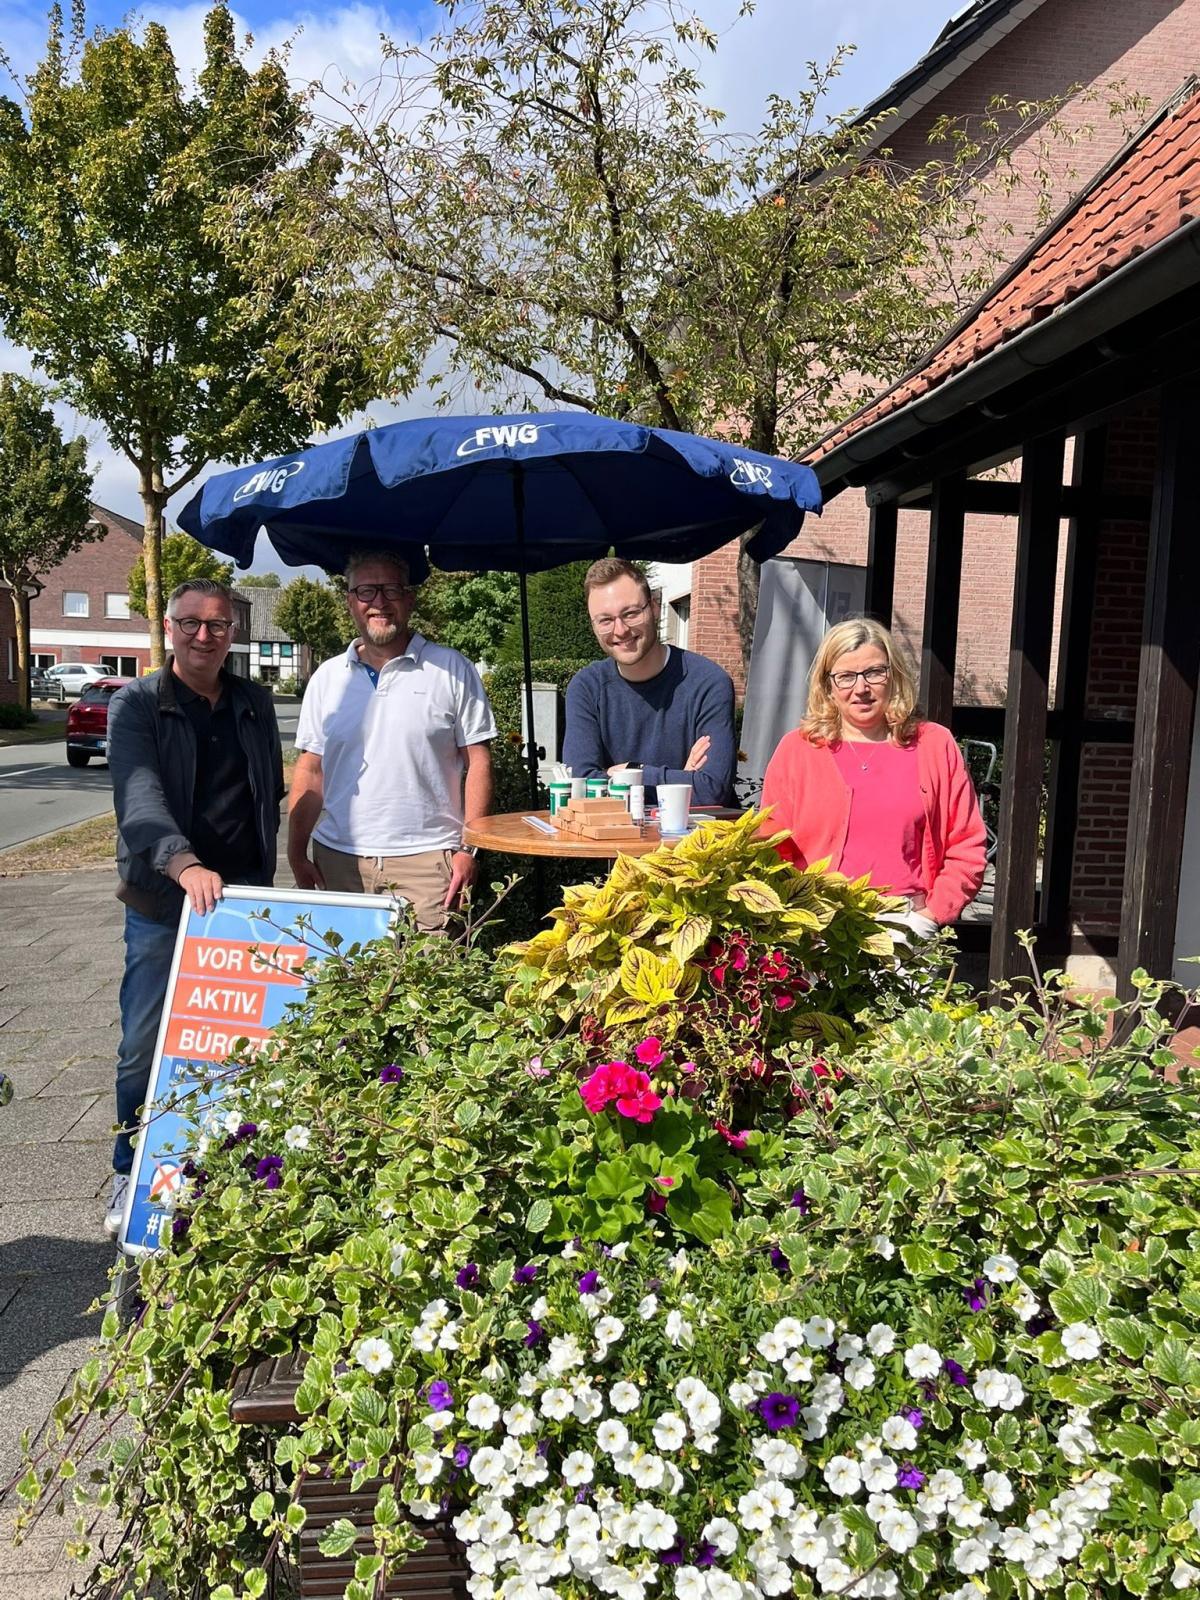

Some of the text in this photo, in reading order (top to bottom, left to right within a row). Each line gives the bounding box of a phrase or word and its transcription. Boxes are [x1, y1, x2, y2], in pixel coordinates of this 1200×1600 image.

[474, 424, 539, 448] FWG
[242, 468, 288, 494] FWG
[196, 945, 299, 976] VOR ORT
[186, 986, 258, 1015] AKTIV.
